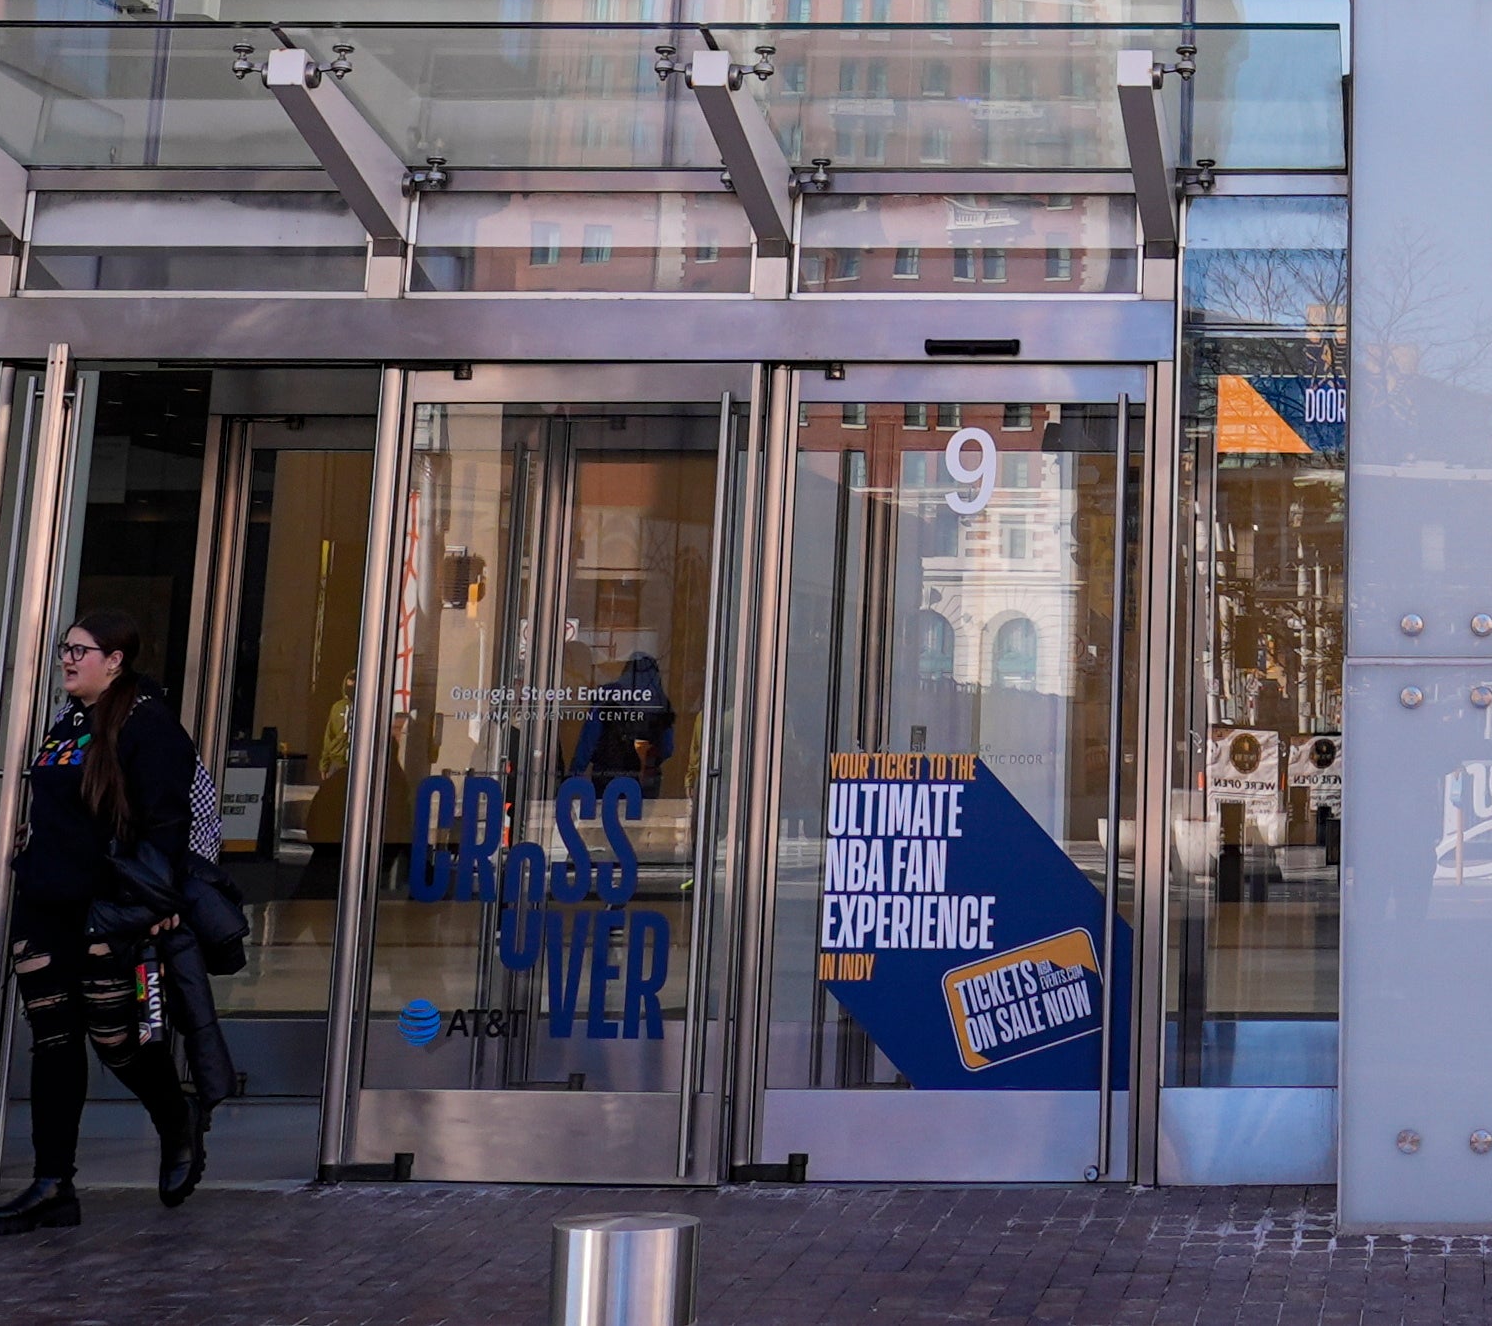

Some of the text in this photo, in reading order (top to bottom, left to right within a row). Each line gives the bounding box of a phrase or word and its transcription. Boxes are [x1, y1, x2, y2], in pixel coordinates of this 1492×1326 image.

[944, 427, 997, 515] 9
[451, 685, 652, 704] Georgia Street Entrance
[515, 711, 594, 721] CONVENTION
[598, 711, 644, 721] CENTER
[830, 753, 976, 780] YOUR TICKET TO THE
[1010, 755, 1043, 765] DOOR
[827, 783, 965, 837] ULTIMATE
[409, 776, 643, 905] CROSS
[824, 838, 947, 893] NBA FAN
[821, 894, 996, 949] EXPERIENCE
[499, 908, 671, 1039] OVER
[819, 953, 875, 981] IN INDY
[954, 959, 1038, 1016] TICKETS
[445, 1009, 525, 1038] AT&T
[964, 980, 1092, 1053] ON SALE NOW
